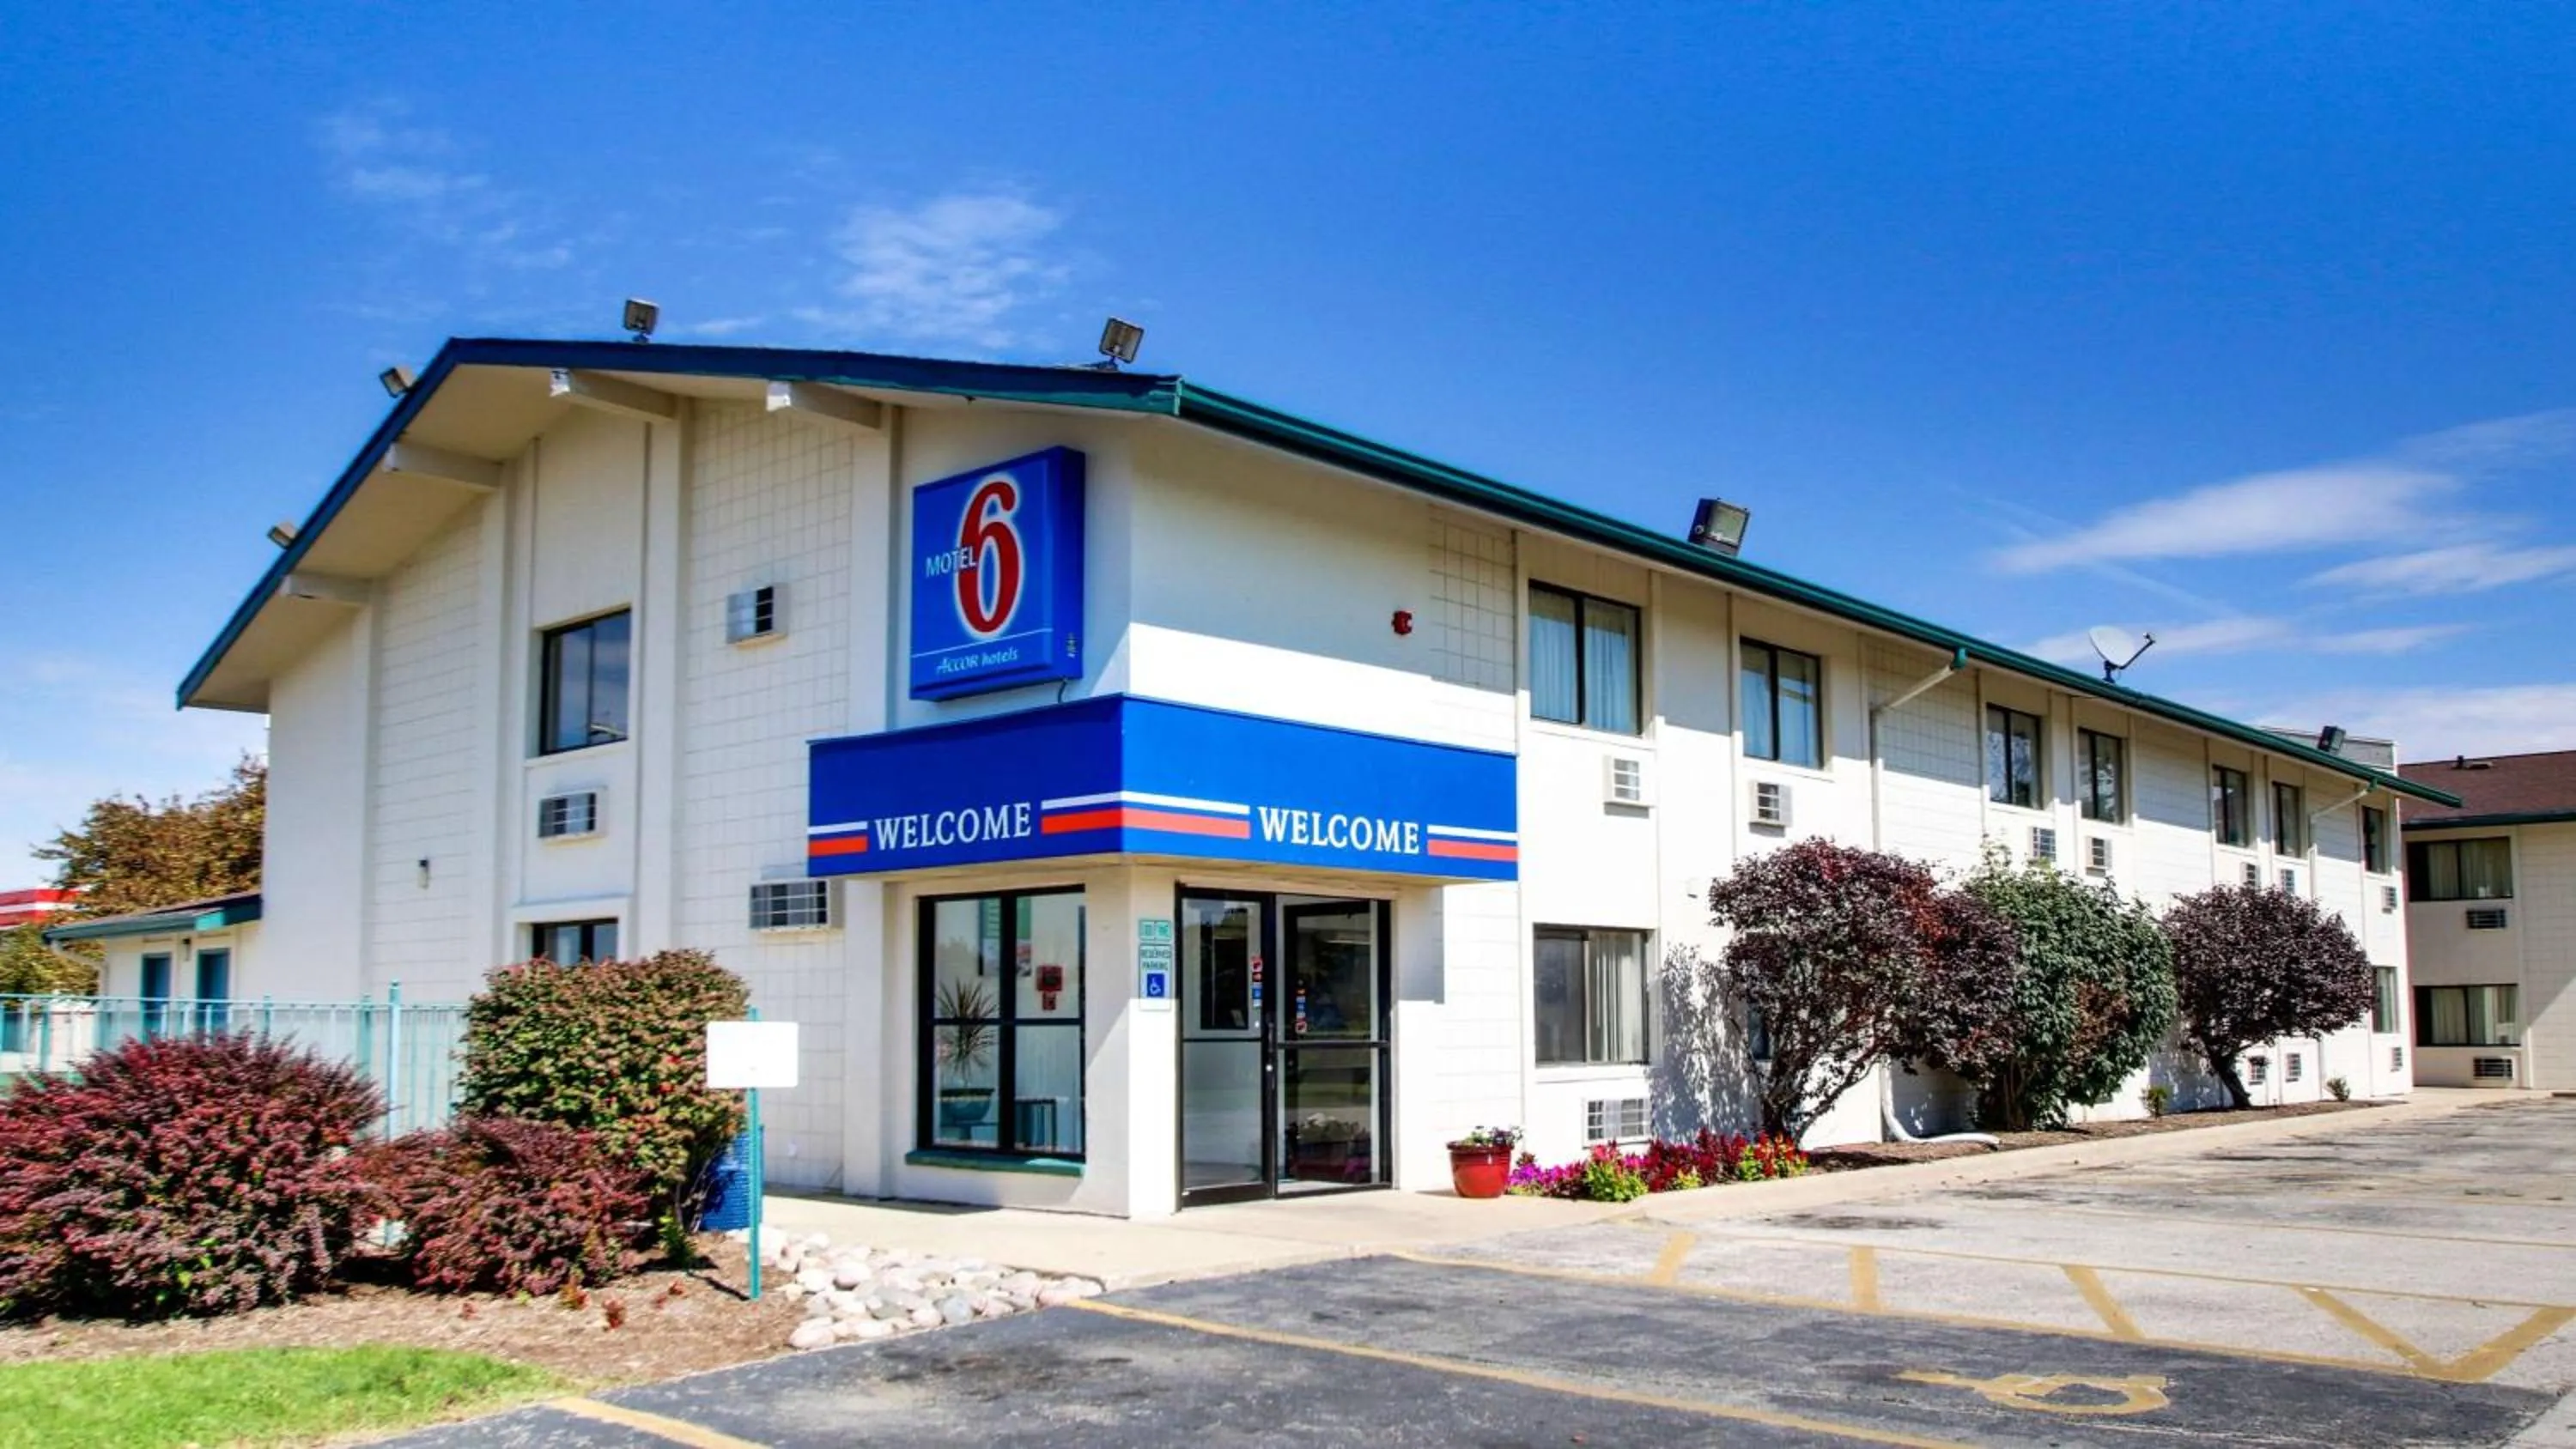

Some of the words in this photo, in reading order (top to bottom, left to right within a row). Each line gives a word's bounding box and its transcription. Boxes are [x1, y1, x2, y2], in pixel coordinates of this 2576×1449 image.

[926, 545, 976, 578] MOTEL
[955, 475, 1023, 637] 6
[981, 646, 1018, 667] hotels
[874, 802, 1031, 851] WELCOME
[1257, 806, 1419, 855] WELCOME
[1142, 961, 1169, 970] PARKING
